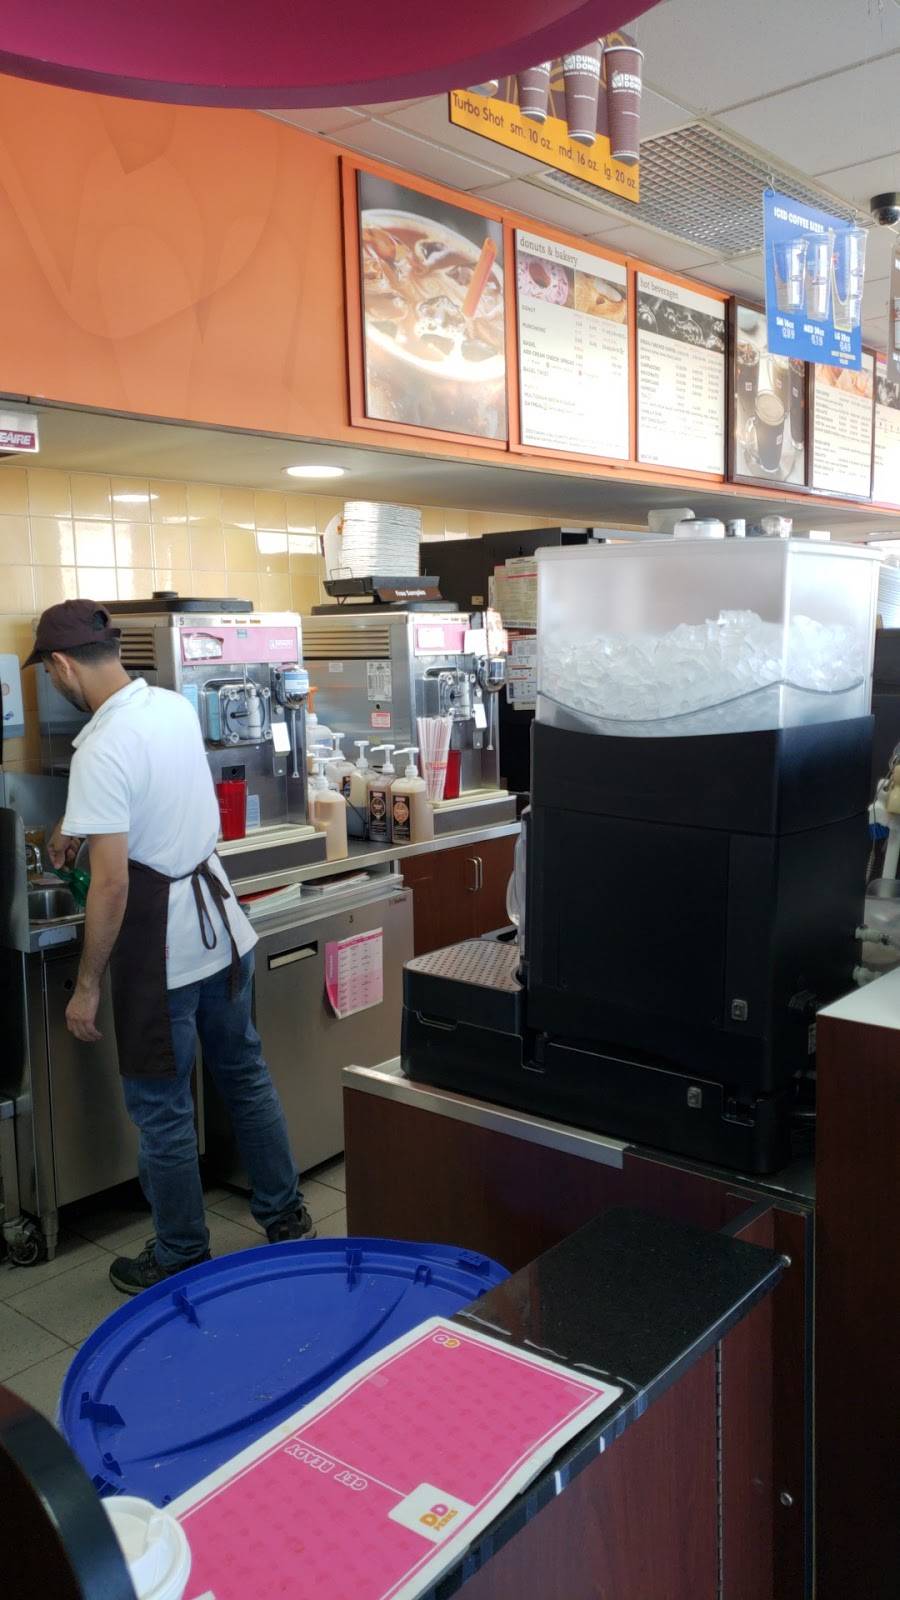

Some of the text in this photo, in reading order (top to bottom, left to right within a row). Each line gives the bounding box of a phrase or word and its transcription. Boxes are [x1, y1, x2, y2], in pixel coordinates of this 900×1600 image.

[453, 92, 480, 117] Turbo
[482, 106, 505, 128] Shot
[510, 123, 526, 138] sm.
[528, 128, 539, 144] 10
[559, 145, 575, 160] md.
[576, 151, 586, 166] 16
[615, 169, 625, 183] 20
[774, 206, 788, 221] ICED
[788, 212, 810, 229] COFFEE
[519, 236, 578, 267] donuts & bakery
[406, 588, 427, 598] Samples
[432, 1334, 461, 1349] GO
[284, 1443, 368, 1491] GET READY
